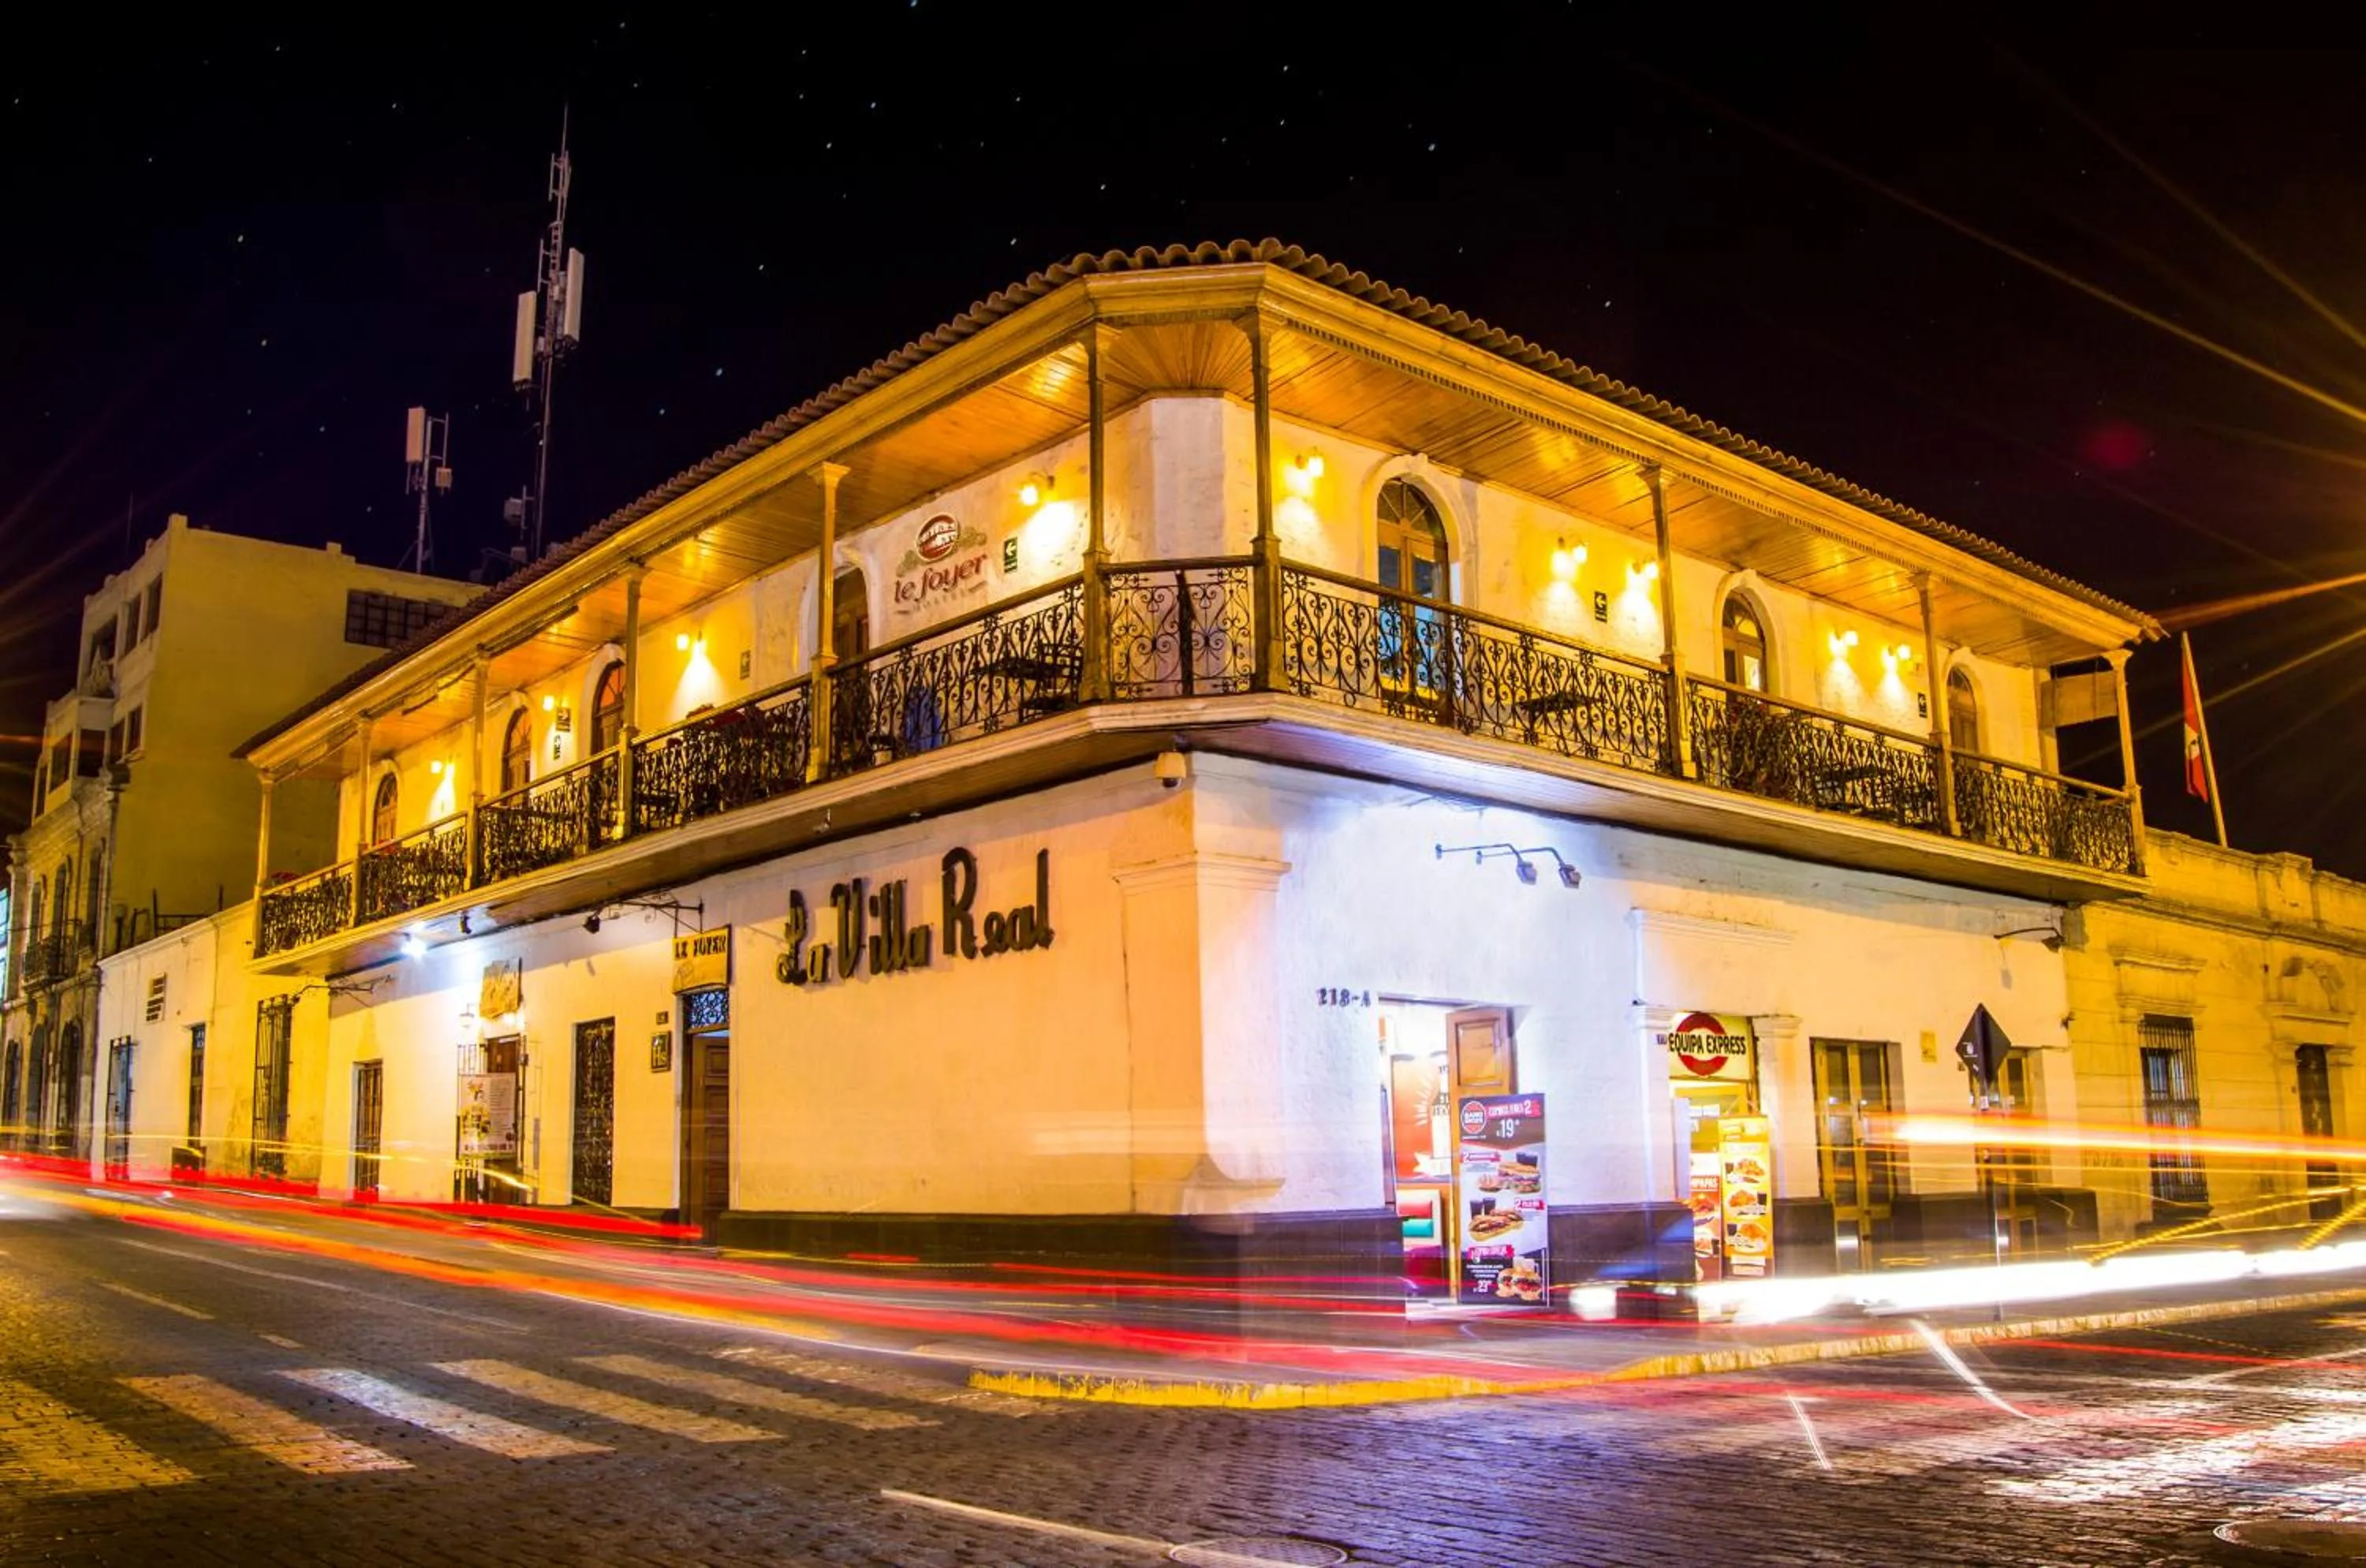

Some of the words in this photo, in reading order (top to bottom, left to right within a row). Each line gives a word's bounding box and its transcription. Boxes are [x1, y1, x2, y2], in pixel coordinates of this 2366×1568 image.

[775, 889, 833, 985] La
[830, 877, 933, 979] Villa
[942, 846, 1054, 959] Real
[1707, 1034, 1746, 1055] EXPRESS
